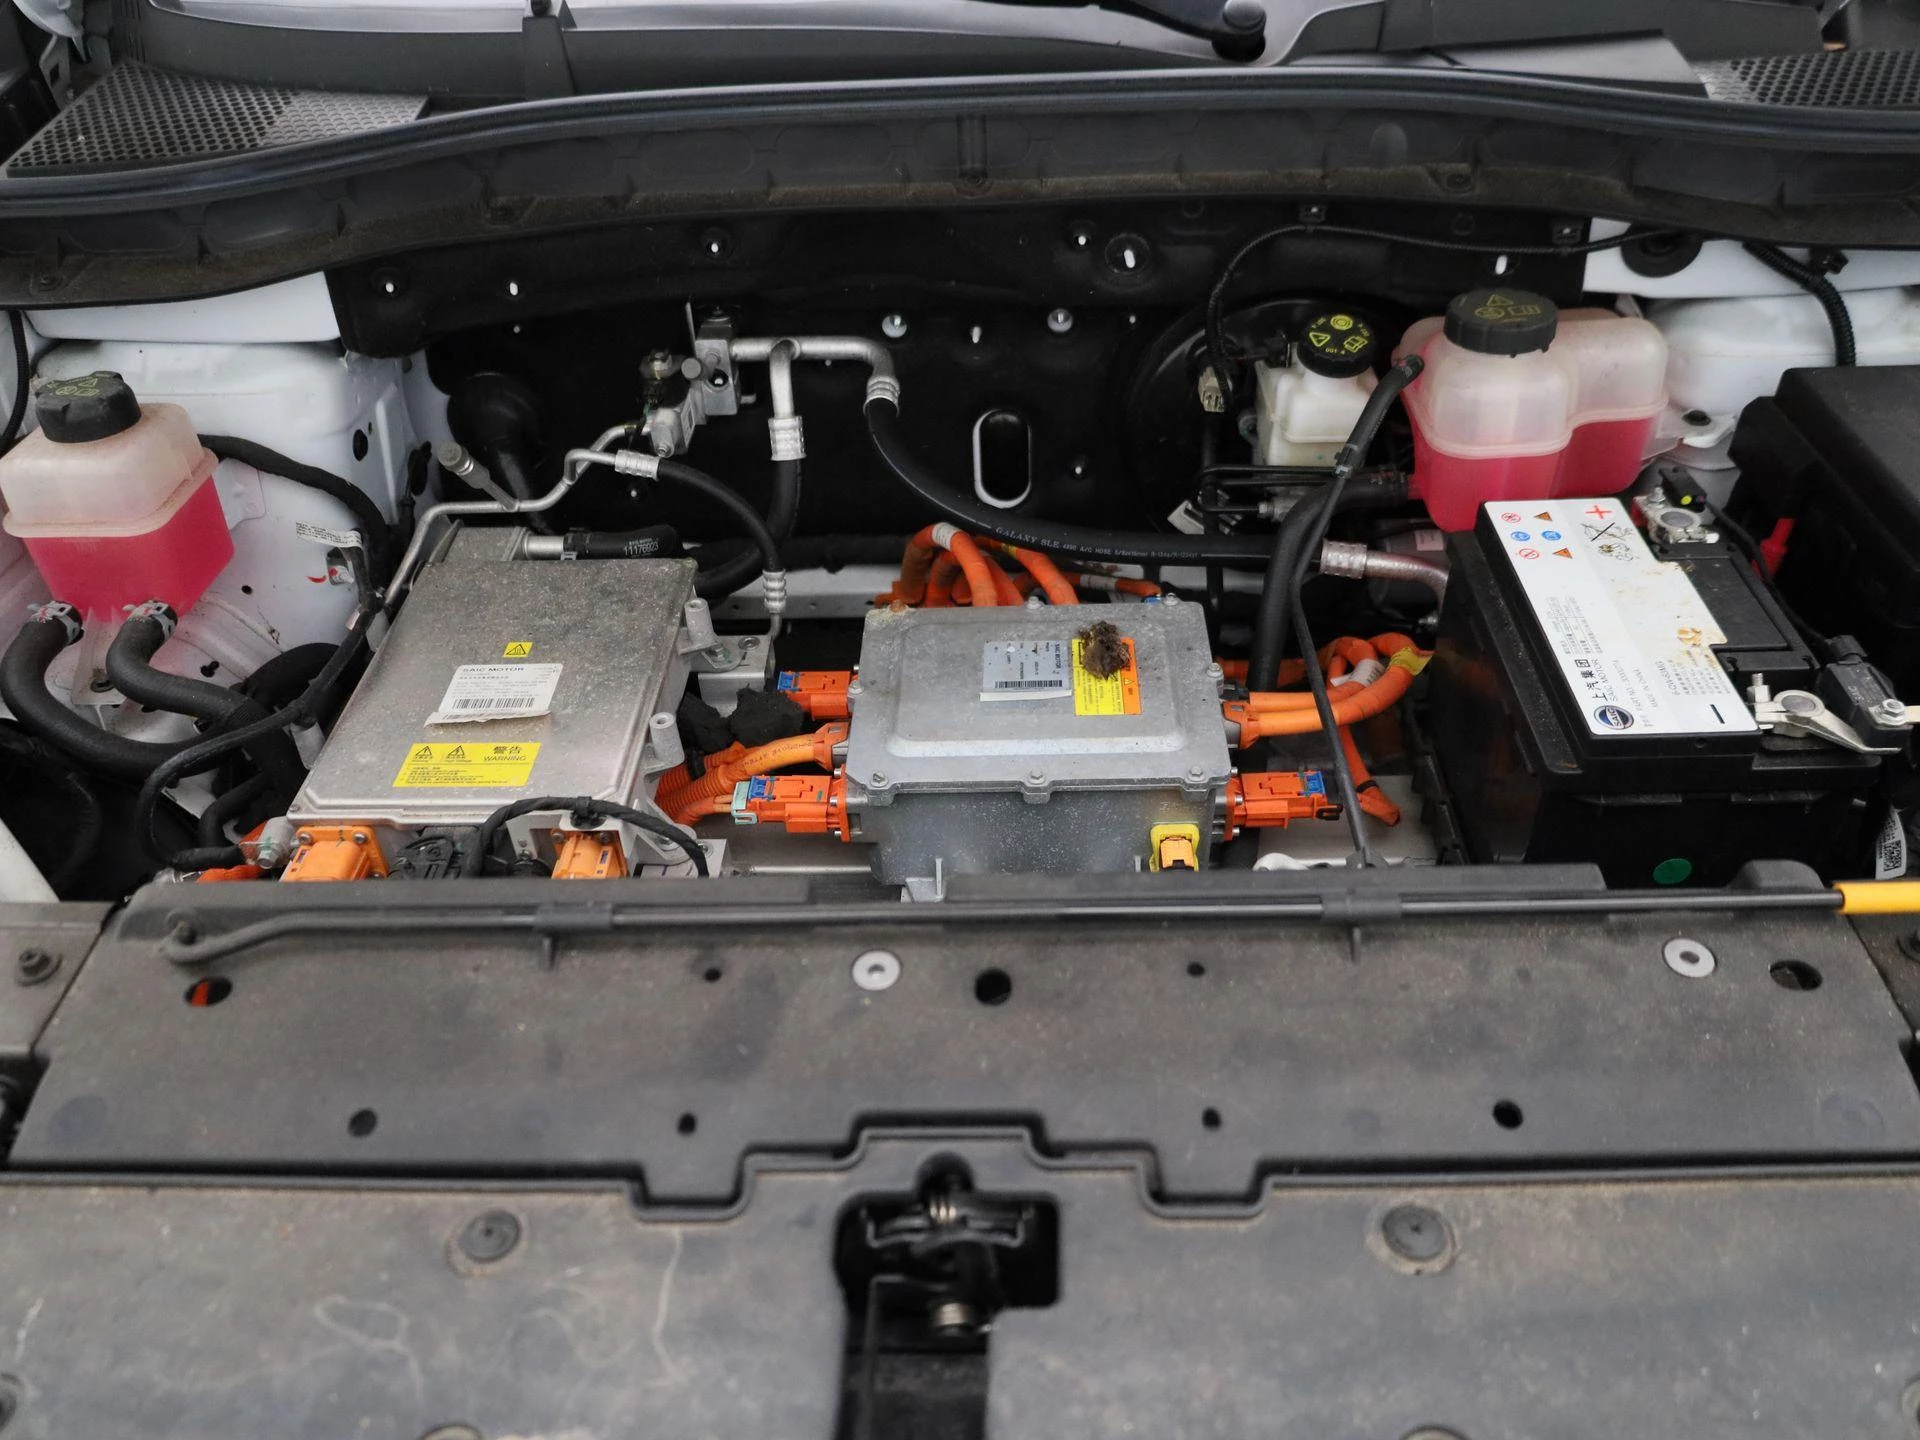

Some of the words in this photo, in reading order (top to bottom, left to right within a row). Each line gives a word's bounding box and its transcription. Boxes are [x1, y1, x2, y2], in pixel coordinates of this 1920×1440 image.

[995, 526, 1038, 544] GALAXY
[1574, 658, 1609, 702] 上汽集团
[1606, 706, 1623, 727] SAIC
